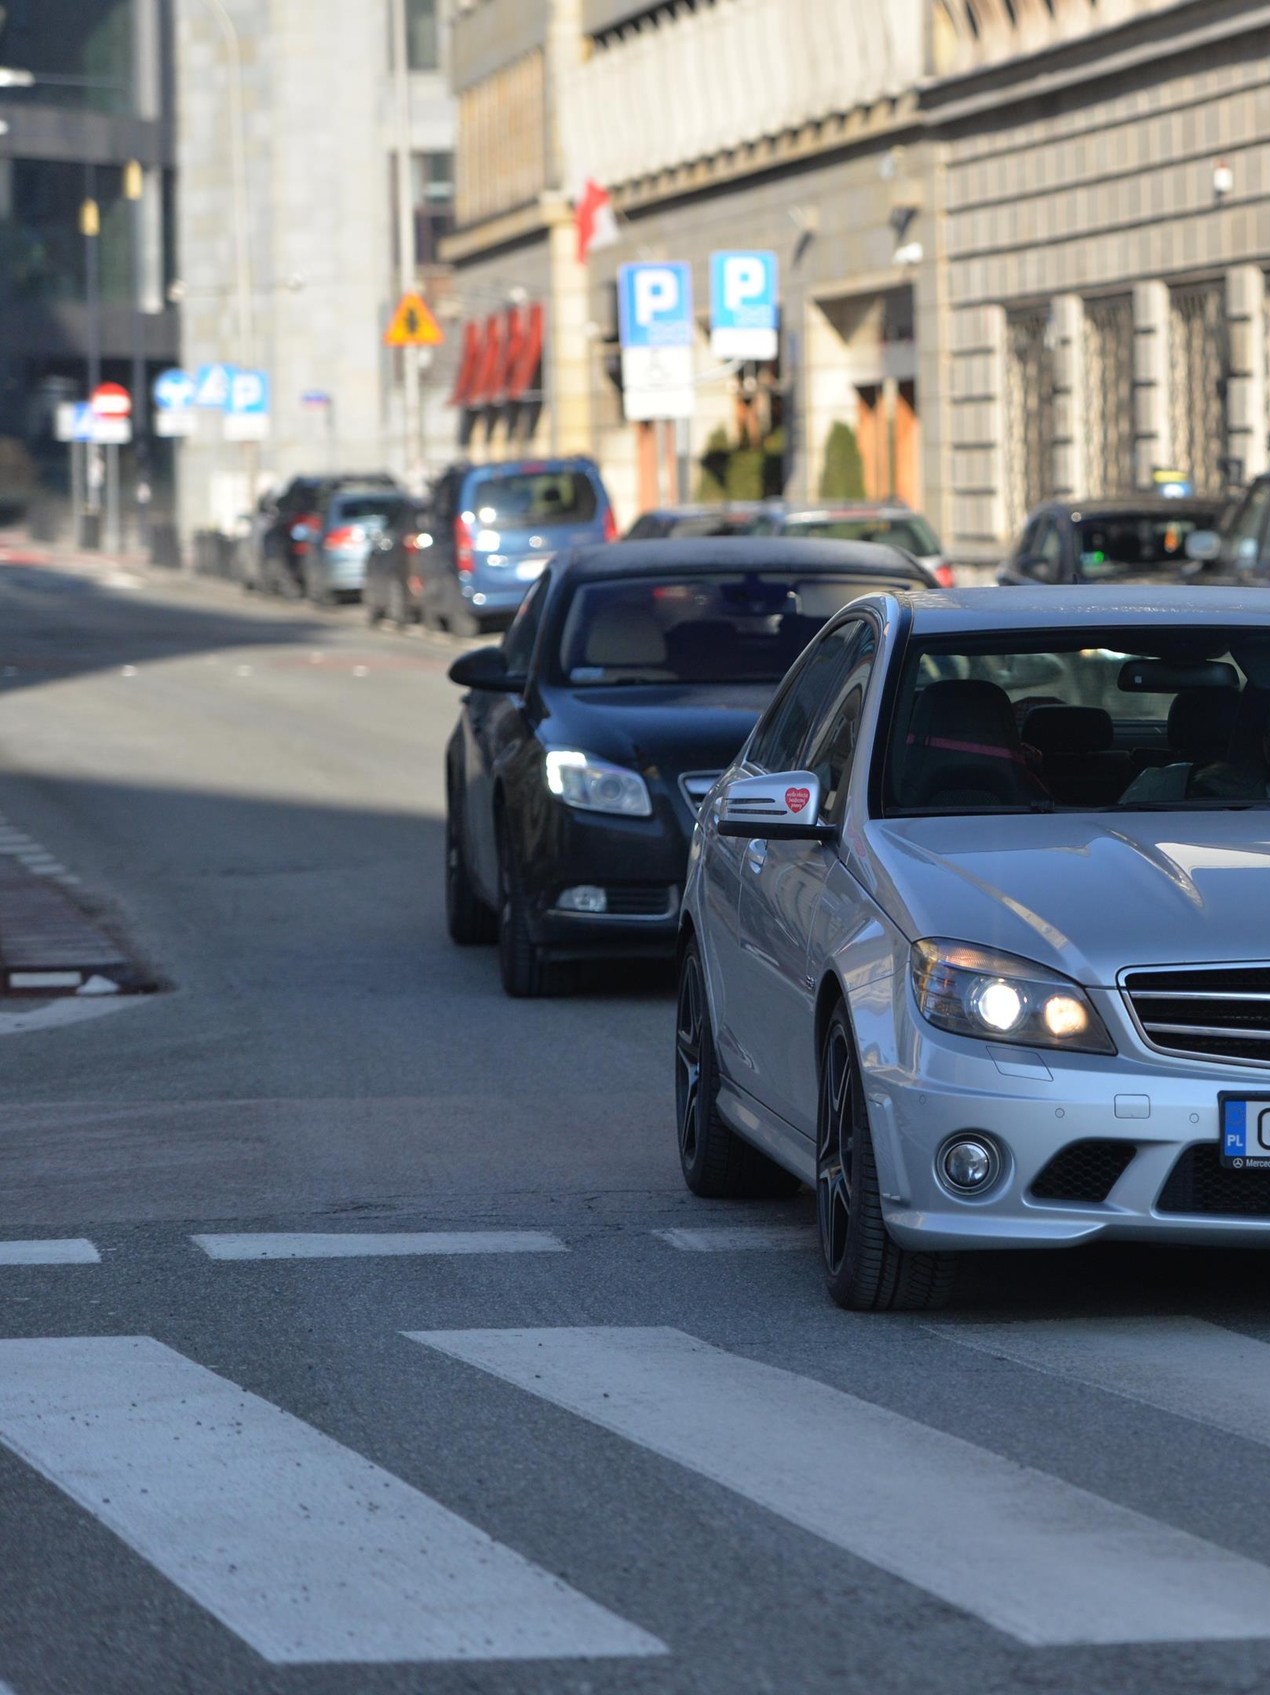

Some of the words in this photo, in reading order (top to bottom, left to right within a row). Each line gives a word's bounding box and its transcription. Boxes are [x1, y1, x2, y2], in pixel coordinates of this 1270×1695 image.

[634, 268, 678, 327] P
[724, 256, 765, 310] P
[1227, 1135, 1243, 1147] PL
